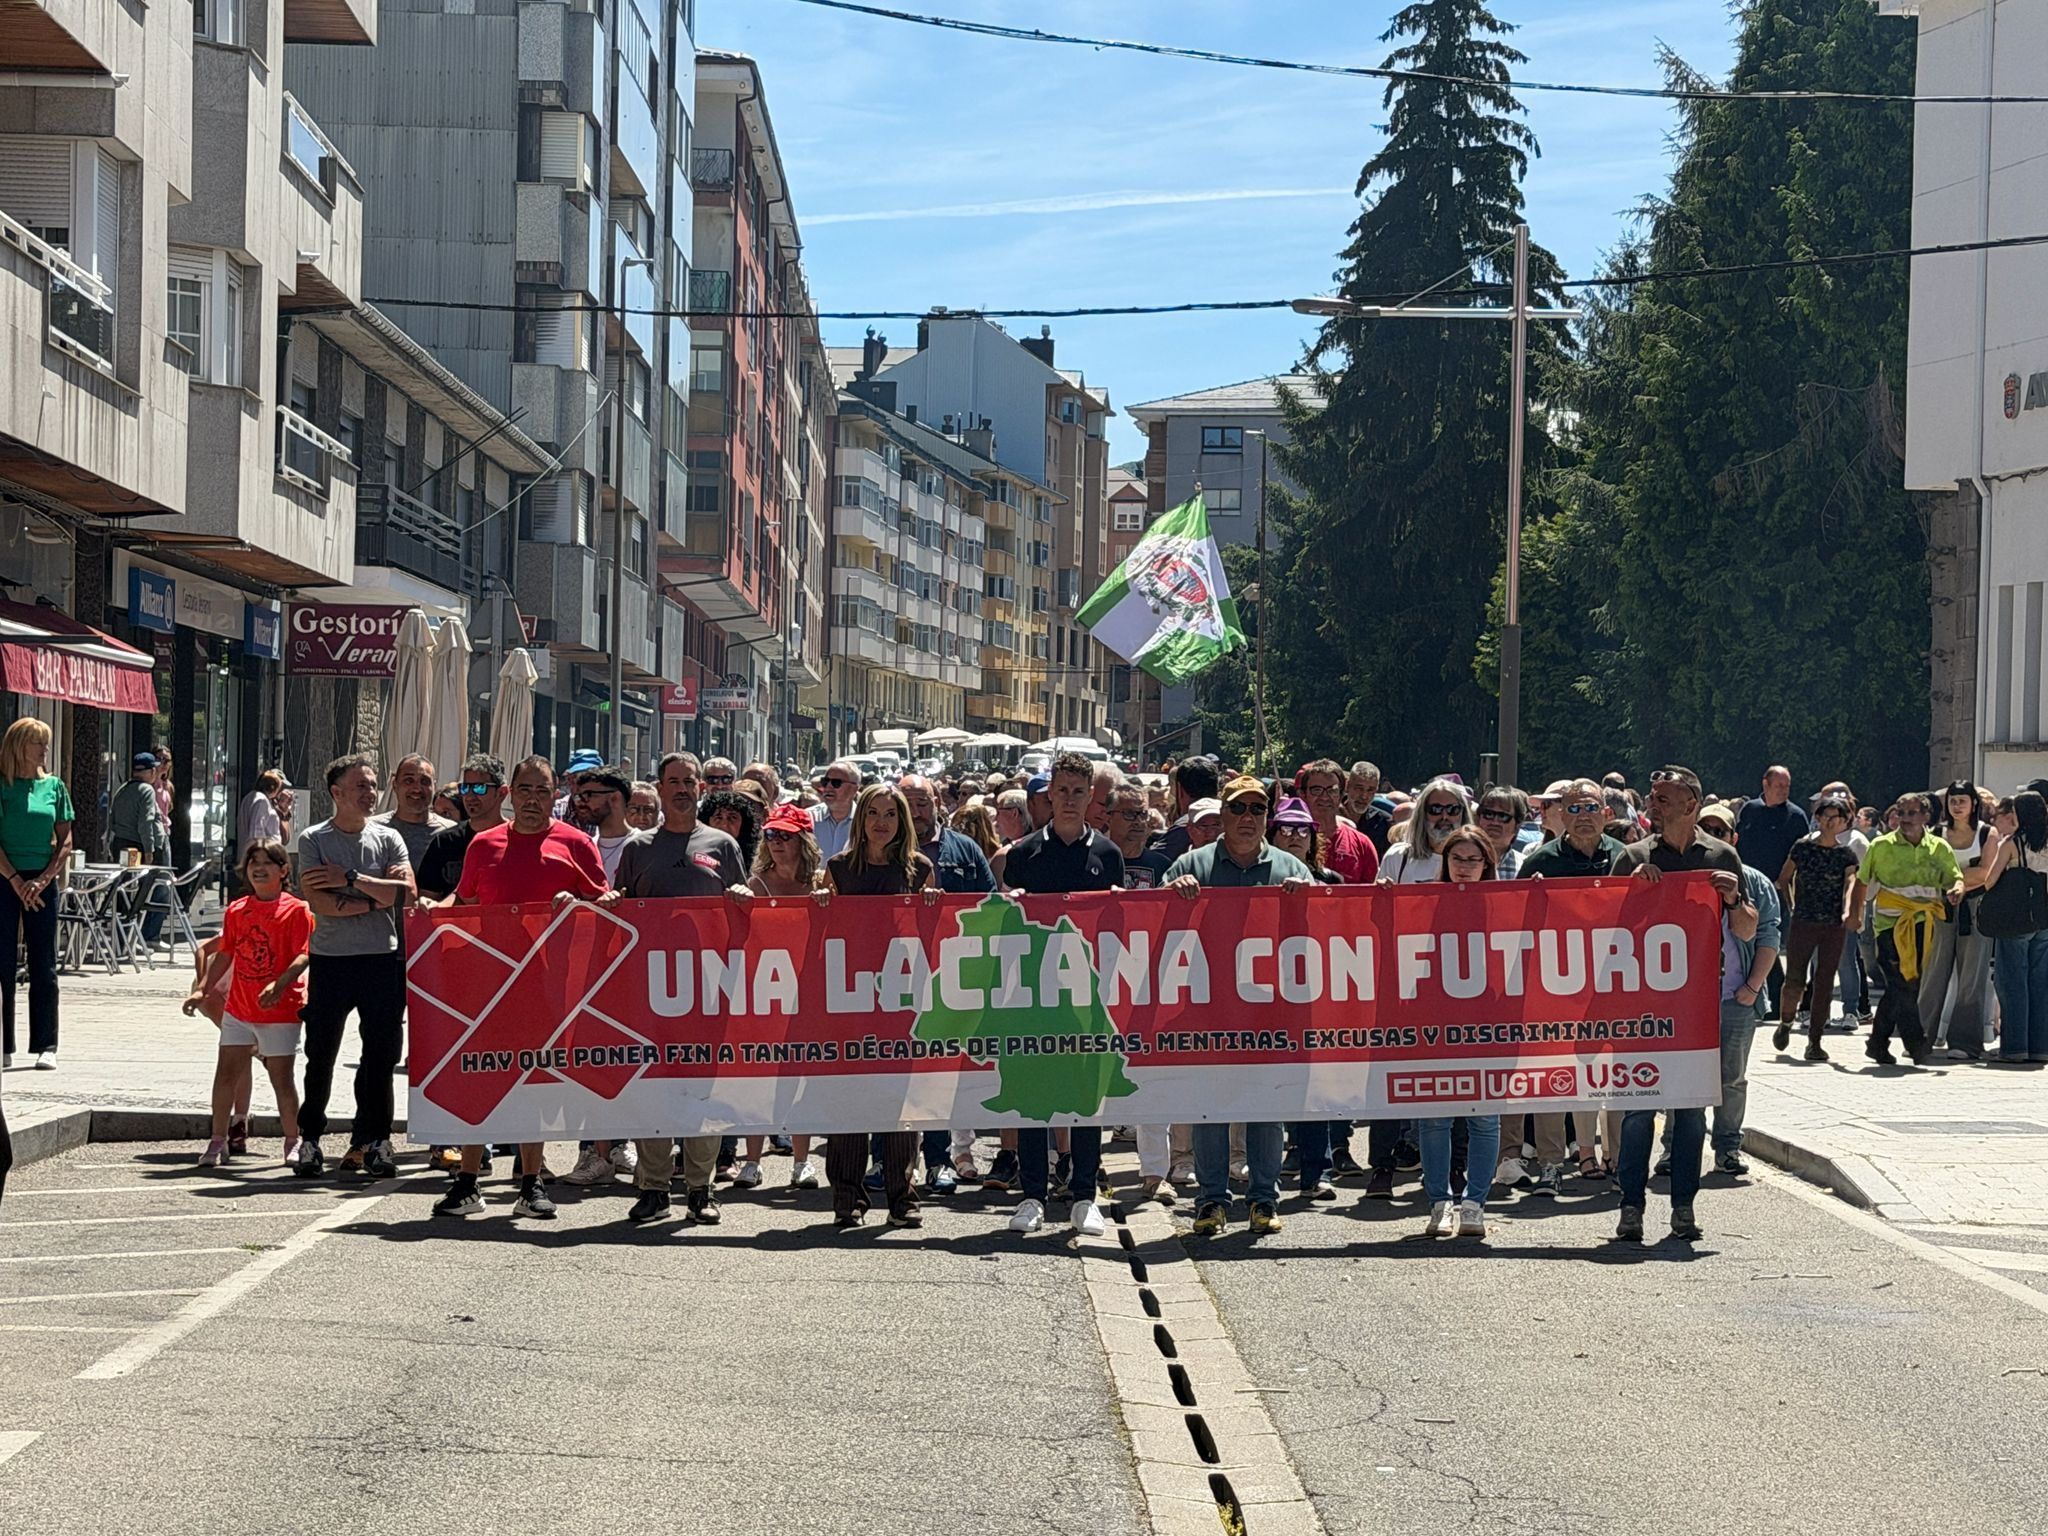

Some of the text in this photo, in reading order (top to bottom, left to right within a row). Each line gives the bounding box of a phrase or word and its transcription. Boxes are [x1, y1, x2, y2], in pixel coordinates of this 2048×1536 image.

[140, 581, 164, 617] Allianz
[293, 607, 402, 636] Gestorí
[317, 636, 397, 672] Veran
[37, 648, 65, 694] BAR
[648, 923, 1688, 1017] UNA LACIANA CON FUTURO
[461, 1014, 1675, 1073] HAY QUE PONER FIN A TANTAS DÉCADAS DE PROMESAS, MENTIRAS, EXCUSAS Y DISCRIMINACIÓN
[1393, 1076, 1475, 1098] CCOO
[1488, 1072, 1547, 1097] UGT
[1586, 1062, 1660, 1089] USO
[1635, 1089, 1661, 1097] OBRERA
